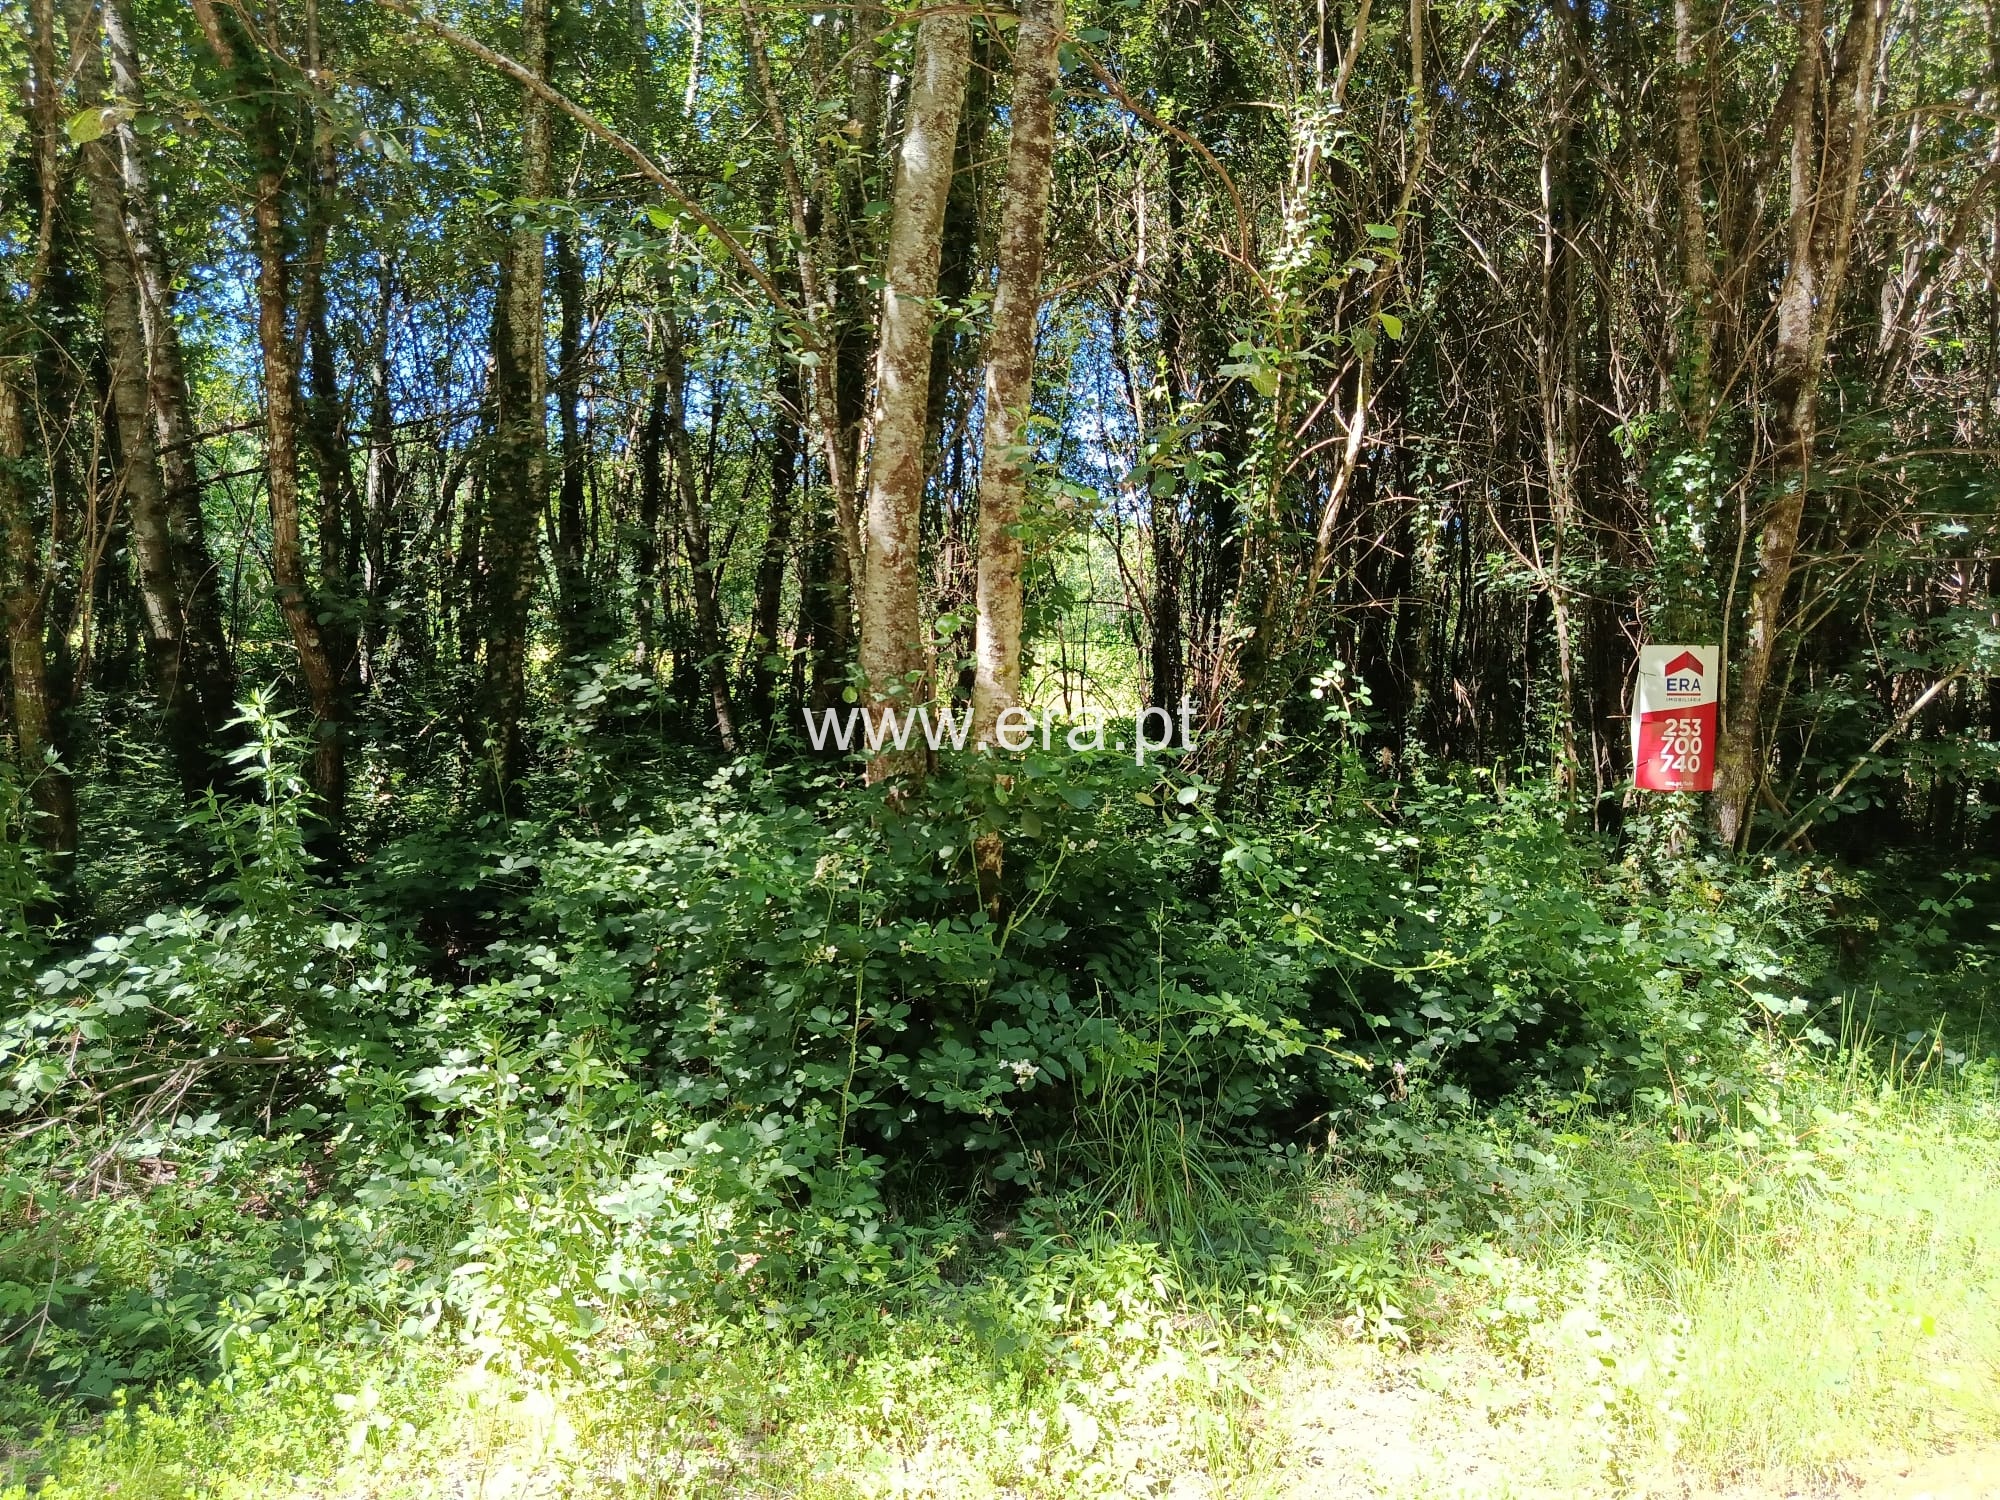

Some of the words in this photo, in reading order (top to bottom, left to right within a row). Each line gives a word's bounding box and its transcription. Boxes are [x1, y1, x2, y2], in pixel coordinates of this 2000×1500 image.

[1666, 678, 1701, 691] ERA
[1663, 718, 1702, 737] 253
[1660, 736, 1703, 755] 700
[1659, 754, 1701, 773] 740
